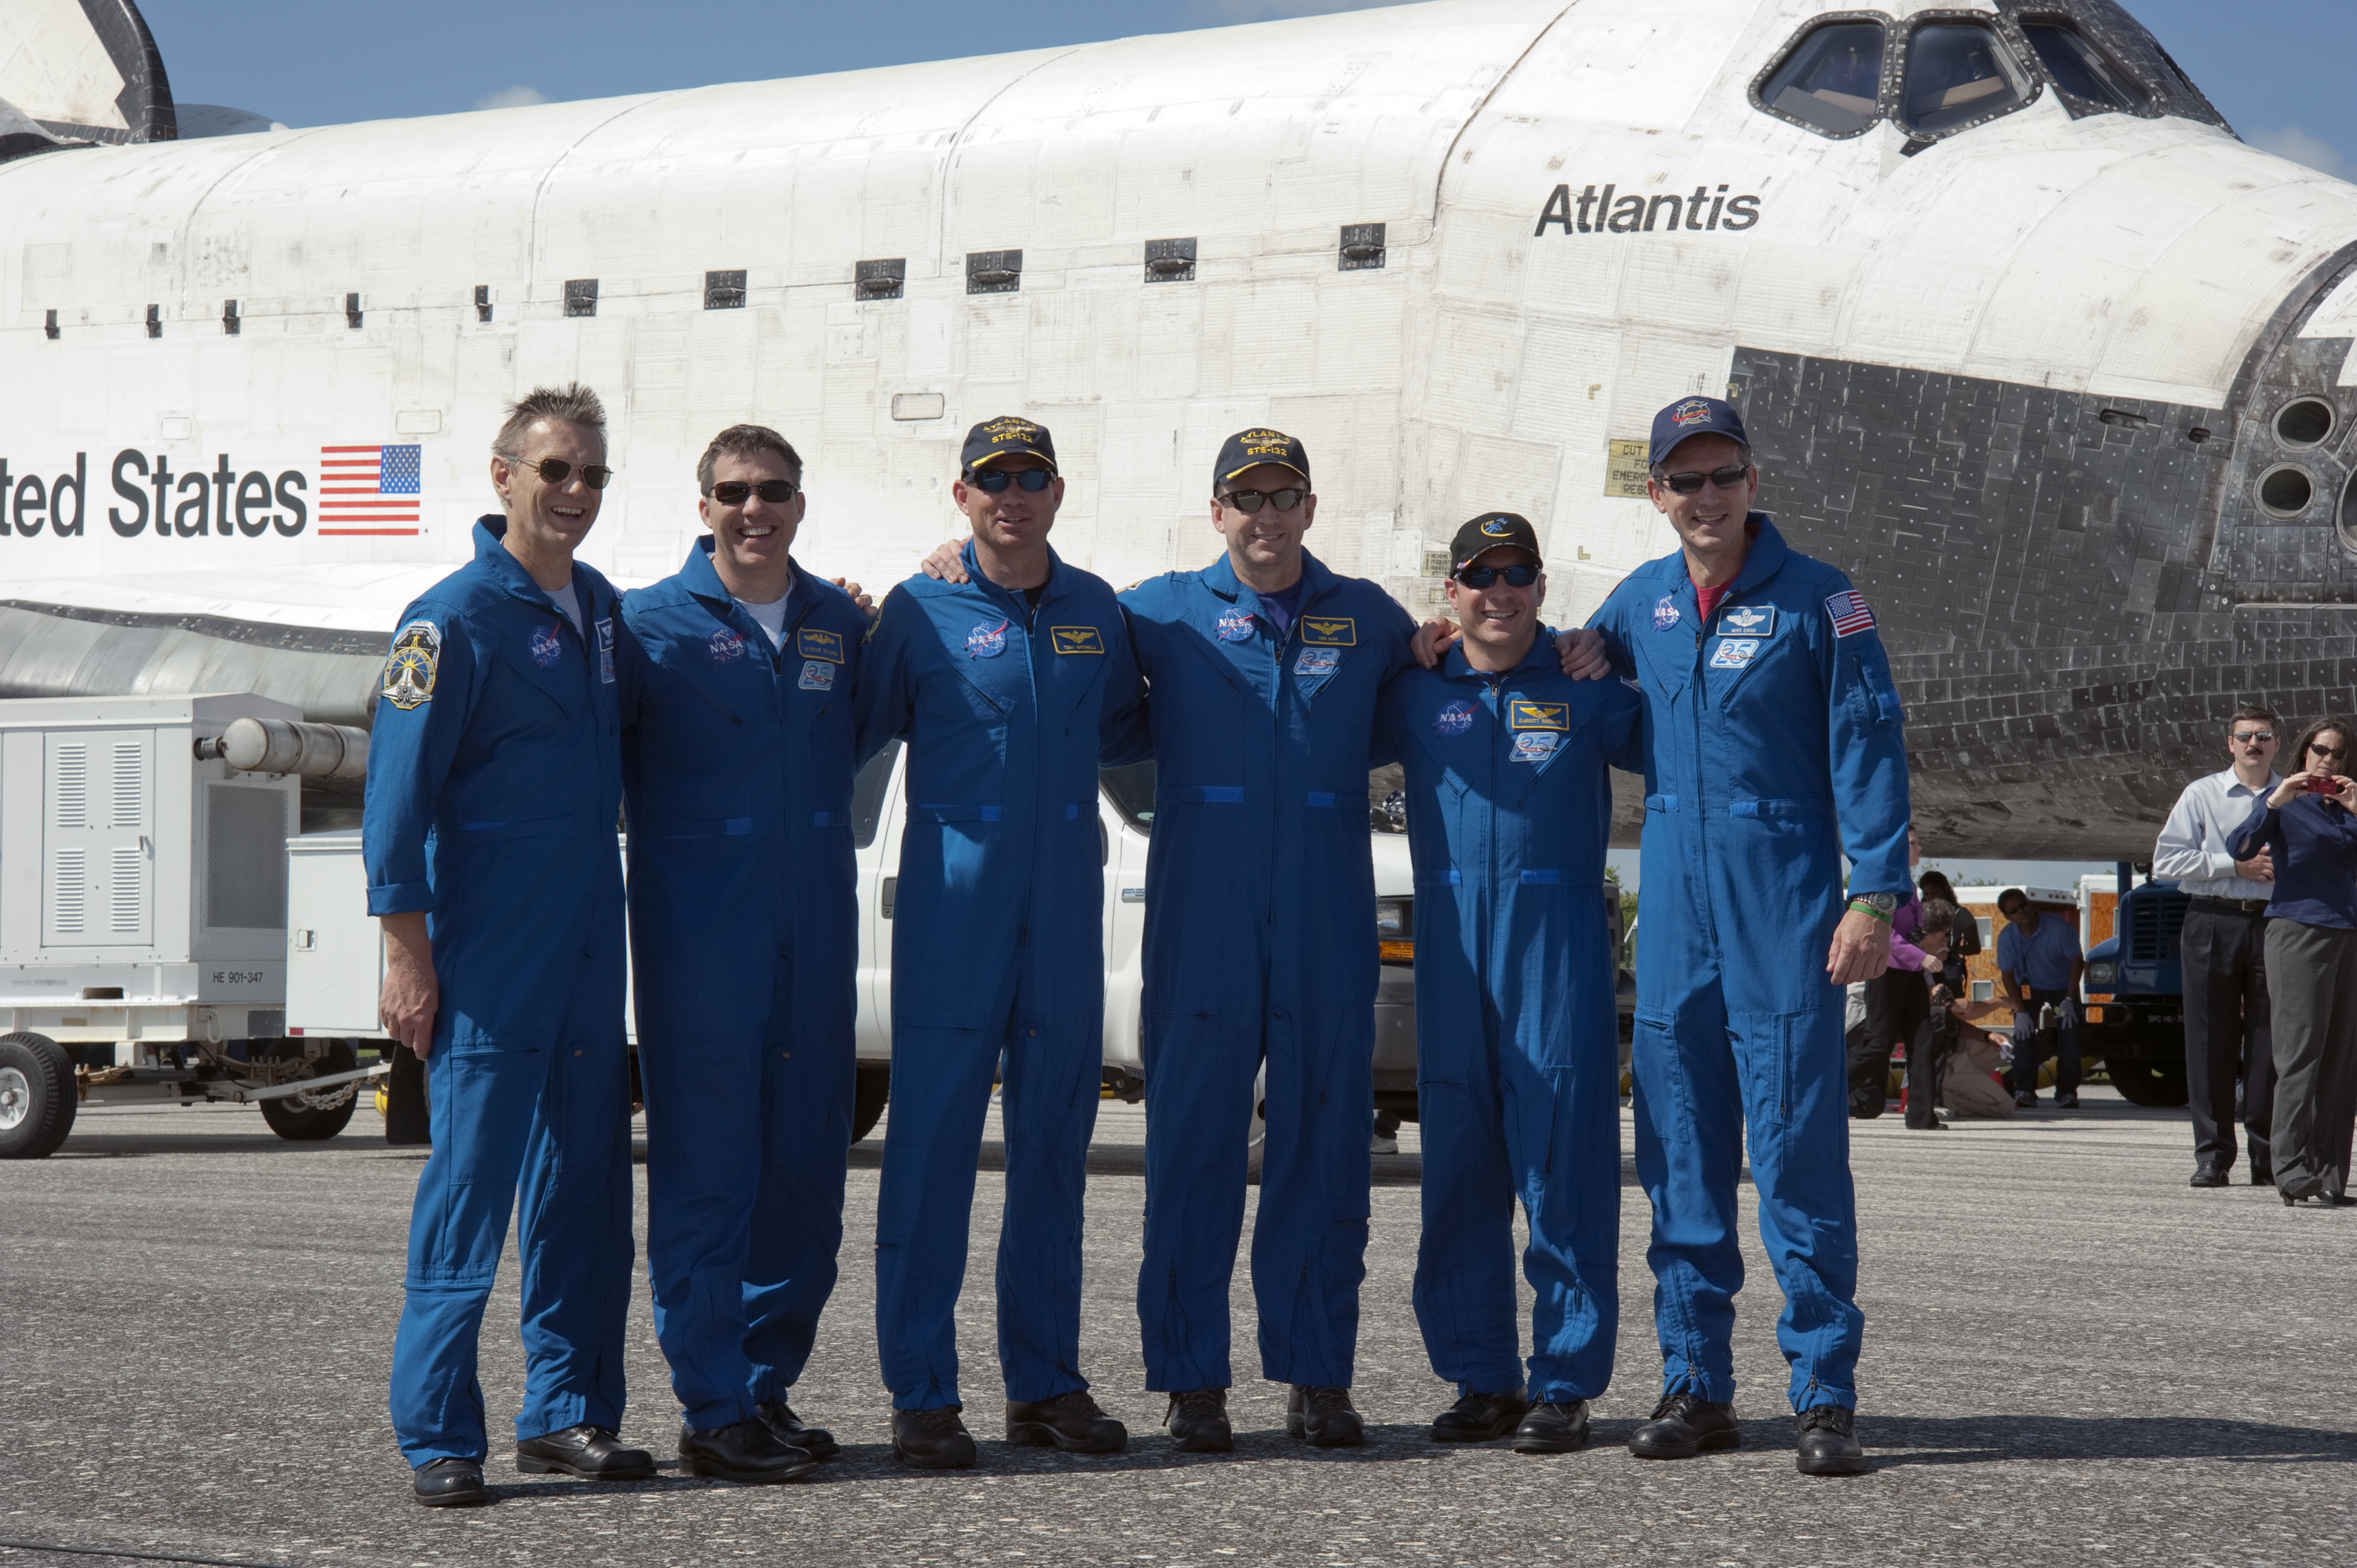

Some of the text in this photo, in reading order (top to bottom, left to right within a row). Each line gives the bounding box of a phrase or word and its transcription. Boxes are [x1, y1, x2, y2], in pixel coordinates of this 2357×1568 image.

[1534, 184, 1761, 236] Atlantis
[992, 432, 1033, 443] STS-132
[1247, 446, 1288, 456] STS-132
[1623, 445, 1643, 456] CUT
[1634, 460, 1649, 469] FO
[108, 449, 307, 537] States
[1655, 607, 1680, 617] NASA
[1219, 618, 1252, 628] NASA
[967, 633, 1003, 646] NASA
[531, 638, 560, 656] NASA
[709, 639, 744, 654] NASA
[1715, 642, 1752, 665] 25
[1299, 650, 1333, 671] 25
[803, 665, 830, 687] 25
[1439, 713, 1472, 723] NASA
[1515, 735, 1552, 758] 25
[213, 972, 263, 983] HE 901-347
